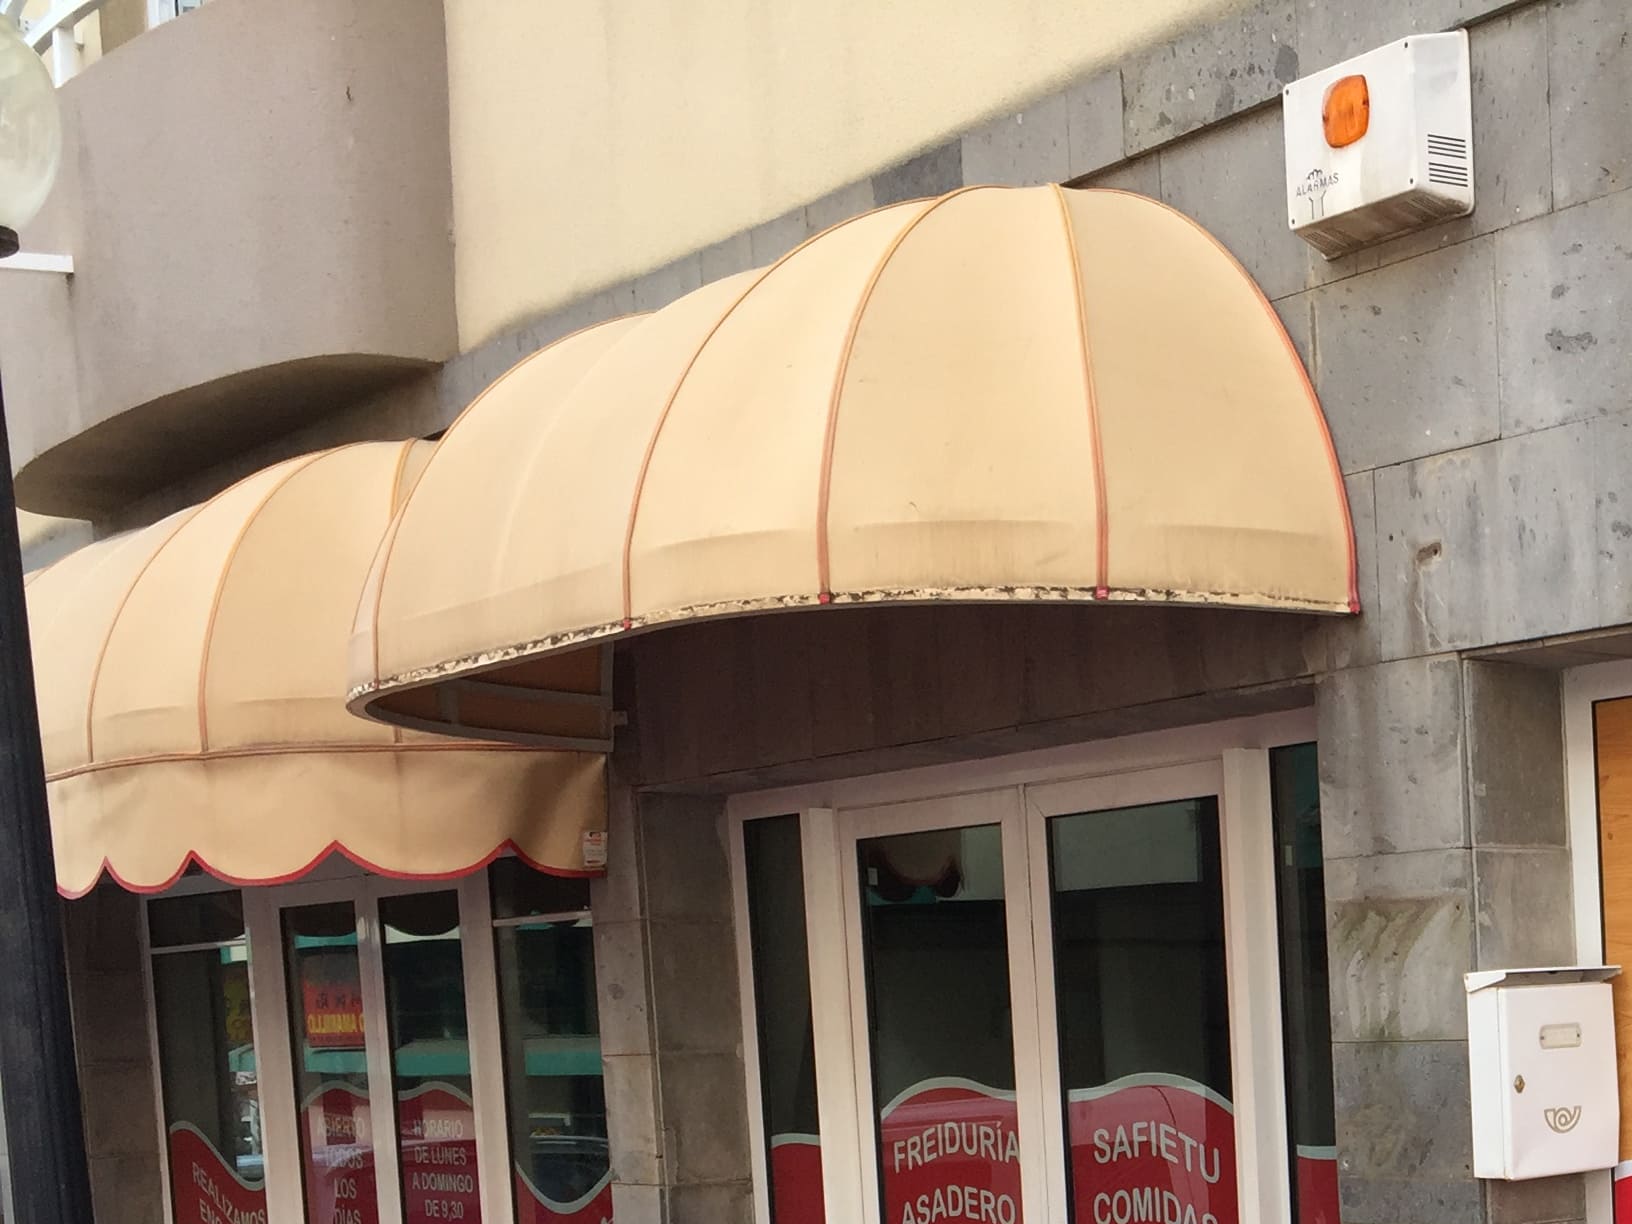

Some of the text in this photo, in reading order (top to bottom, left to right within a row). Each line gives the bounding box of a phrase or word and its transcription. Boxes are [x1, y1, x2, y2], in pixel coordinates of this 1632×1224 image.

[1295, 172, 1339, 197] ALARMAS
[413, 1118, 465, 1139] HORARIO
[414, 1146, 467, 1167] DE LUNES
[893, 1120, 1021, 1174] FREIDURÍA
[1093, 1119, 1221, 1184] SAFIETU
[333, 1177, 357, 1200] LOS
[411, 1171, 475, 1194] A DOMINGO
[424, 1198, 440, 1218] DE
